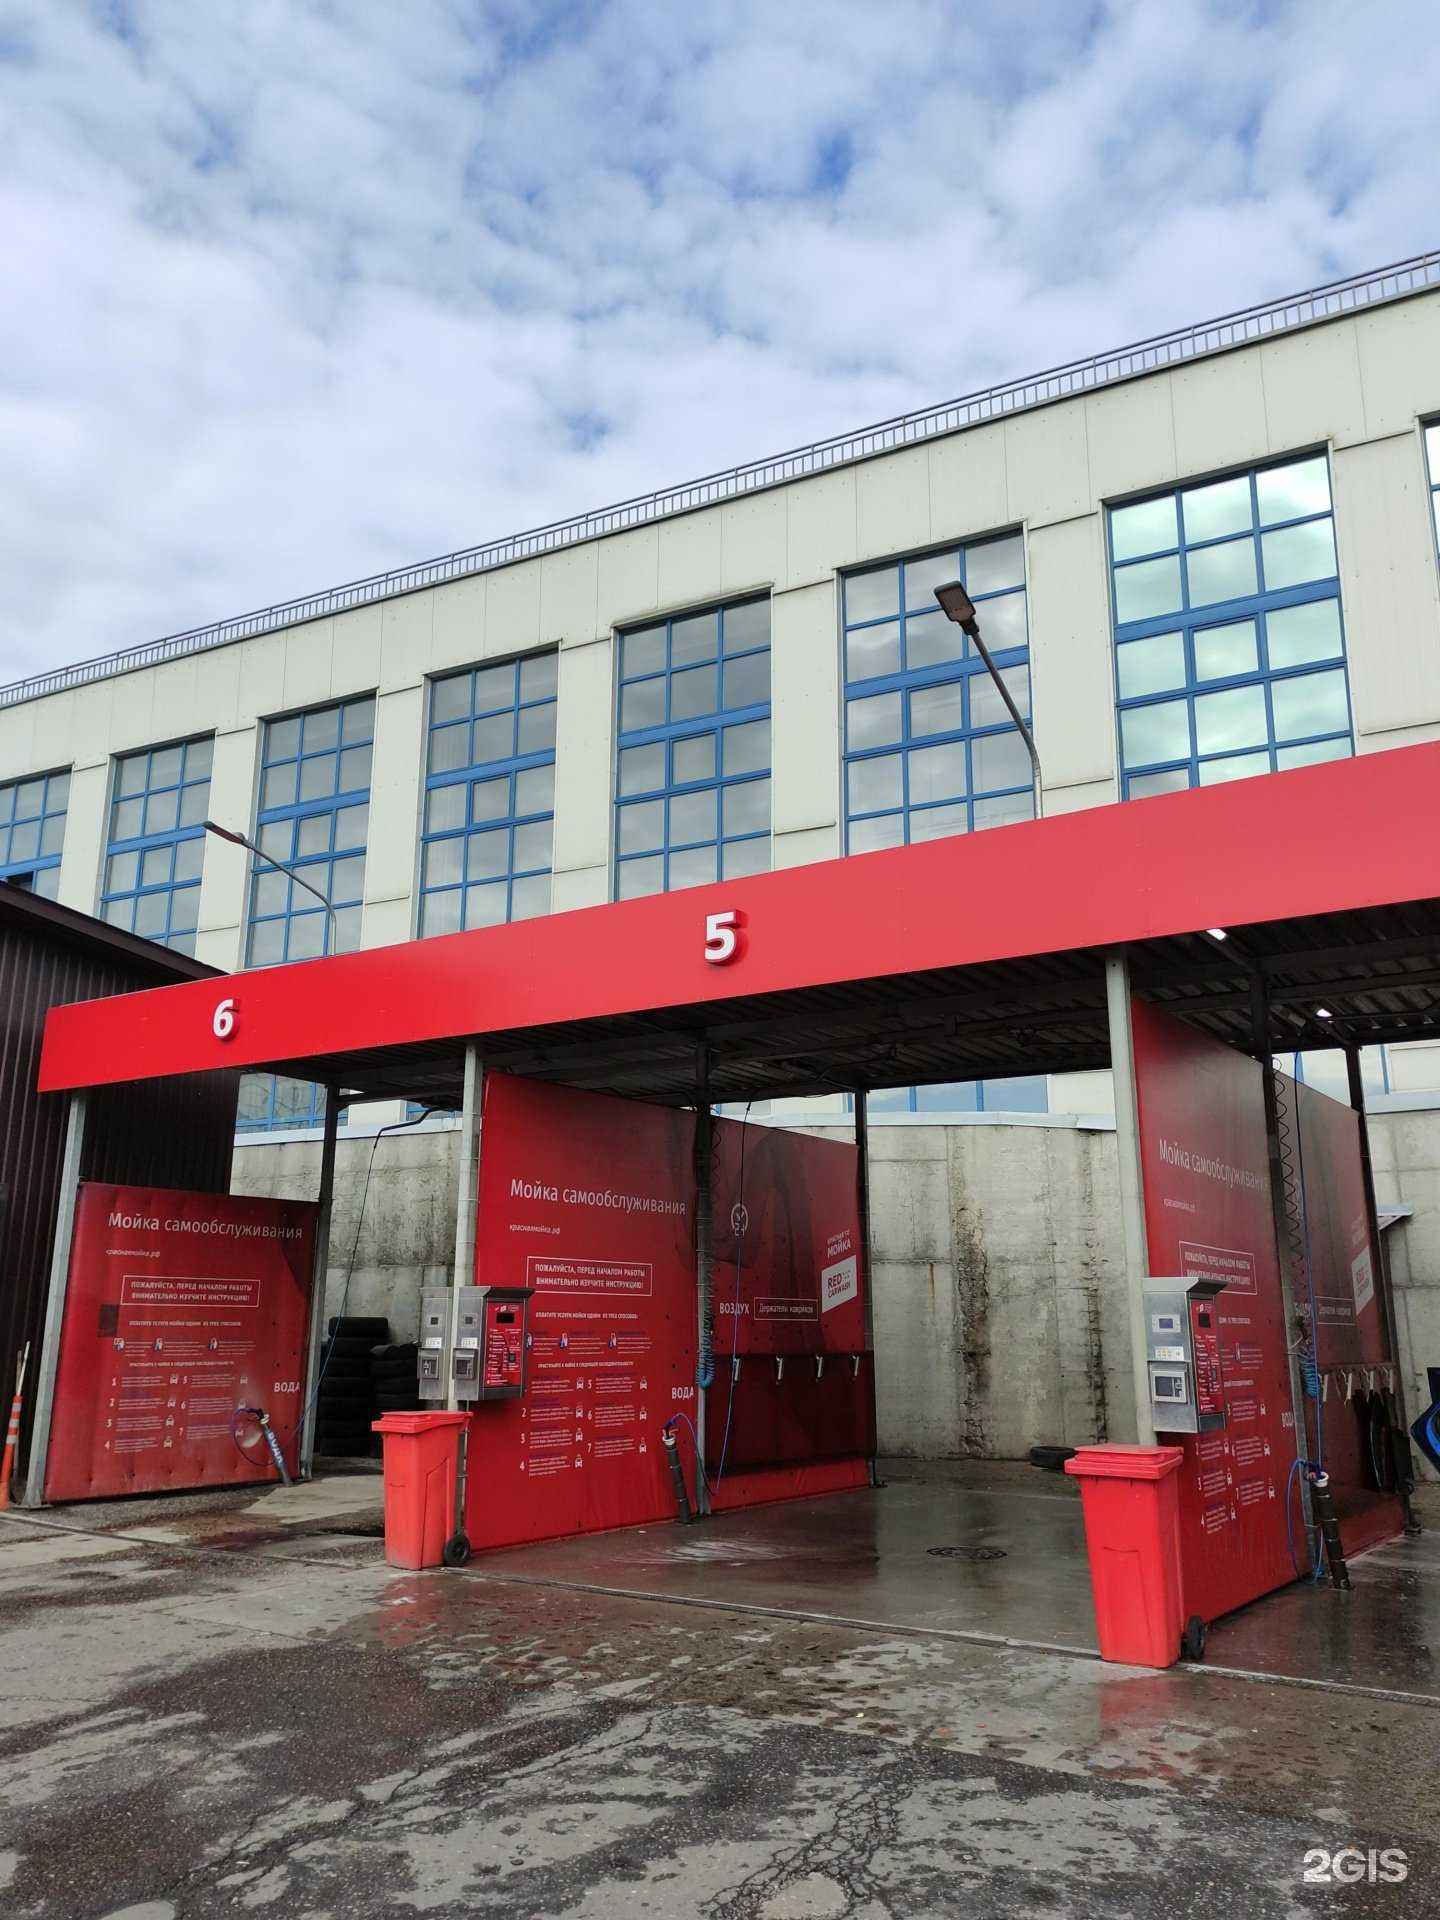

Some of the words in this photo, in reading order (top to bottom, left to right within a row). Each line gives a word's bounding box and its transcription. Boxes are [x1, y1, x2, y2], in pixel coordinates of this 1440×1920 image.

[704, 910, 736, 962] 5
[212, 998, 234, 1038] 6
[1159, 1139, 1190, 1169] Мойка
[510, 1178, 558, 1201] Мойка
[563, 1188, 686, 1216] самообслуживания
[108, 1212, 160, 1230] Мойка
[164, 1218, 303, 1240] самообслуживания
[827, 1238, 851, 1258] МОЙКА
[535, 1263, 576, 1274] ПОЖАЛУЙСТА,
[577, 1266, 595, 1275] ПЕРЕД
[596, 1267, 623, 1276] НАЧАЛОМ
[624, 1269, 645, 1277] РАБОТЫ
[536, 1277, 579, 1287] ВНИМАТЕЛЬНО
[580, 1279, 604, 1287] ИЗУЧИТЕ
[827, 1272, 843, 1289] RED
[719, 1302, 750, 1315] ВОЗДУХ
[273, 1381, 301, 1393] ВОДА
[671, 1387, 694, 1400] ВОДА
